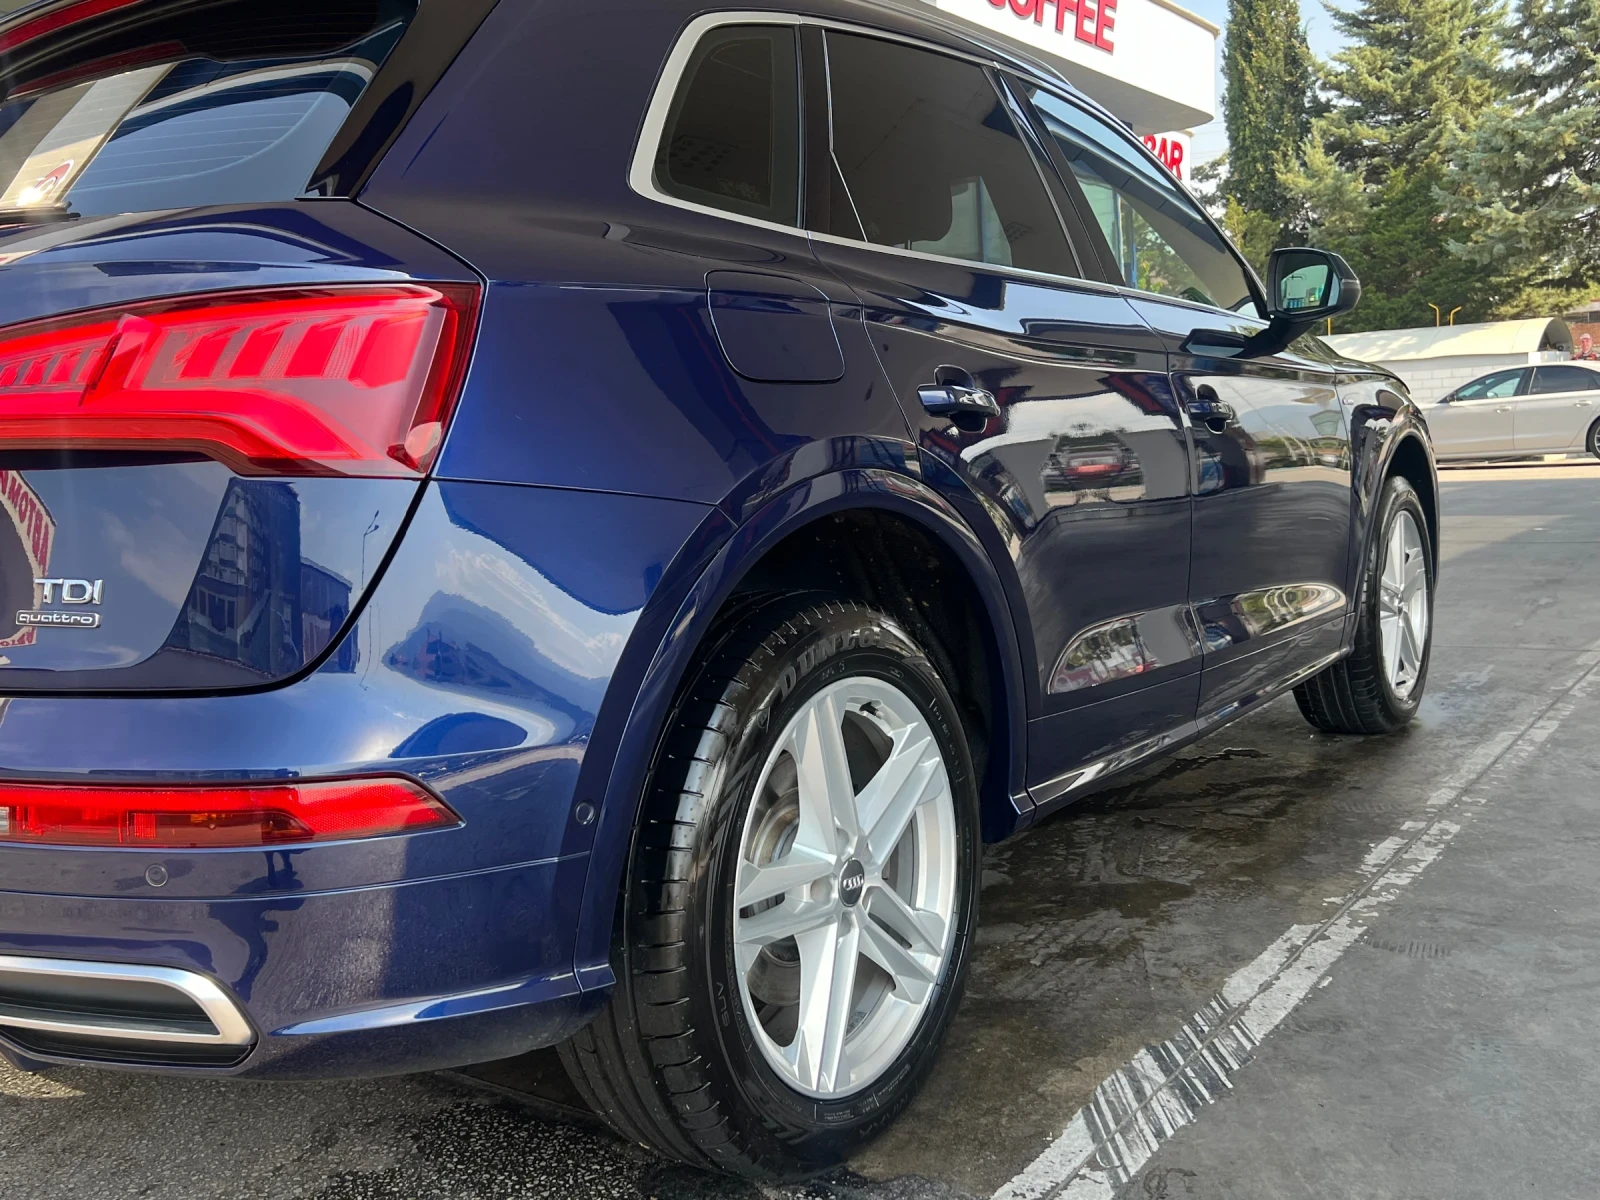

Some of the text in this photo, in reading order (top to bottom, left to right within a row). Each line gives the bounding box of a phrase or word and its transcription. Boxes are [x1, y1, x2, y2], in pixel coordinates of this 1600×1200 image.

[987, 0, 1117, 53] FEE
[34, 578, 103, 605] TDI
[19, 613, 94, 624] quattro
